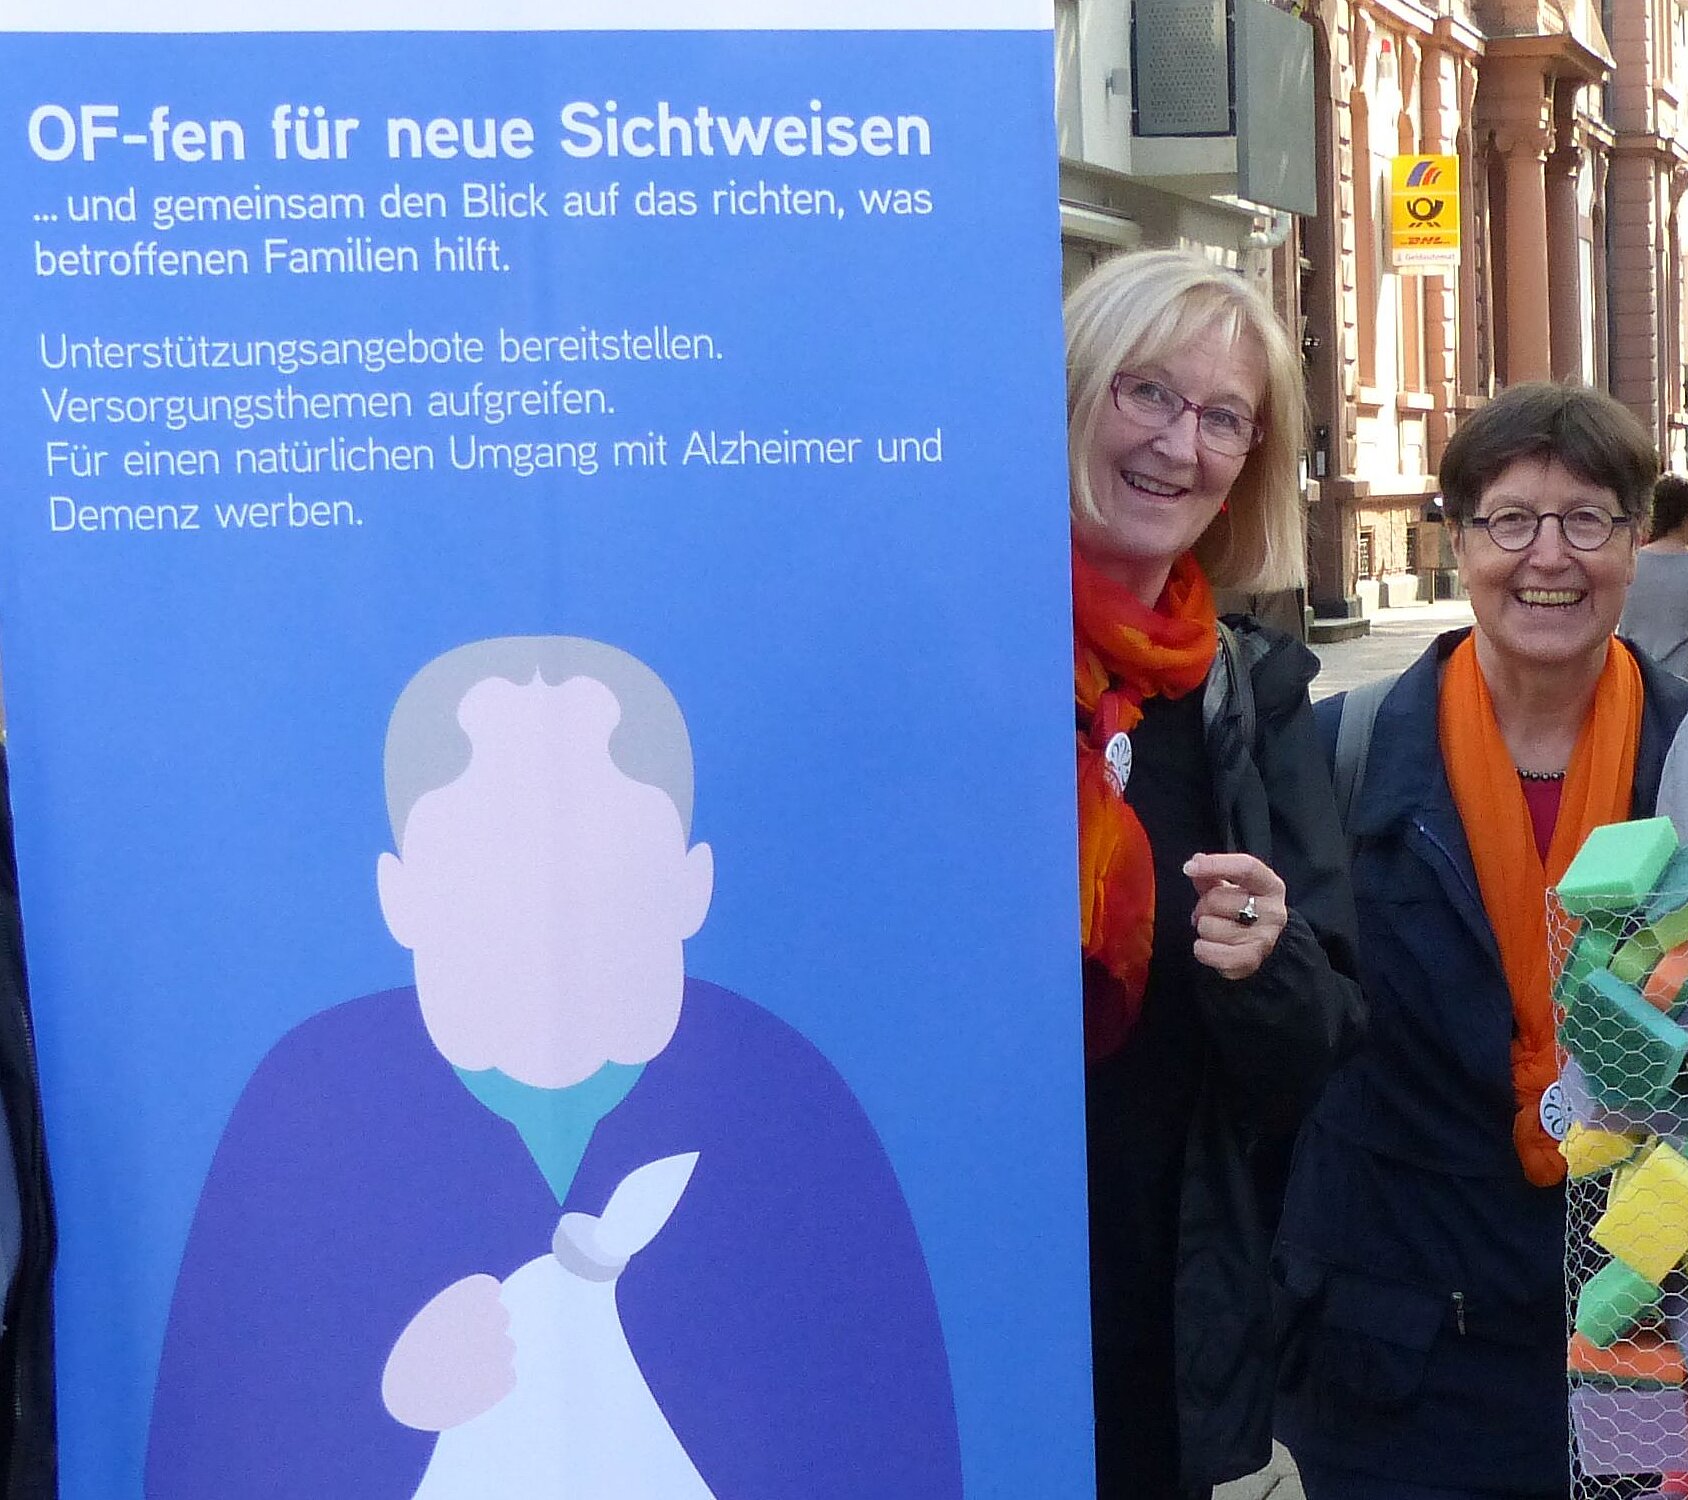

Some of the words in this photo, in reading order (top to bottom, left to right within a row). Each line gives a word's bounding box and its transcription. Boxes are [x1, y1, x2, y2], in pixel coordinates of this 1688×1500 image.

[28, 104, 245, 162] OF-fen
[272, 104, 359, 160] für
[388, 118, 534, 159] neue
[560, 99, 930, 158] Sichtweisen
[154, 184, 364, 230] gemeinsam
[380, 183, 446, 218] den
[463, 182, 548, 217] Blick
[564, 182, 619, 216] auf
[635, 181, 697, 216] das
[713, 180, 844, 220] richten,
[859, 189, 932, 214] was
[35, 241, 248, 276] betroffenen
[265, 237, 418, 273] Familien
[434, 236, 509, 271] hilft.
[1407, 236, 1443, 245] DHL
[41, 329, 484, 374] Unterstützungsangebote
[500, 325, 722, 362] bereitstellen.
[42, 385, 411, 430] Versorgungsthemen
[428, 380, 614, 424] aufgreifen.
[47, 442, 108, 477] Für
[124, 441, 219, 476] einen
[236, 437, 433, 473] natürlichen
[450, 435, 598, 476] Umgang
[614, 432, 666, 466] mit
[683, 430, 862, 465] Alzheimer
[878, 428, 942, 462] und
[50, 496, 200, 531] Demenz
[215, 493, 362, 528] werben.
